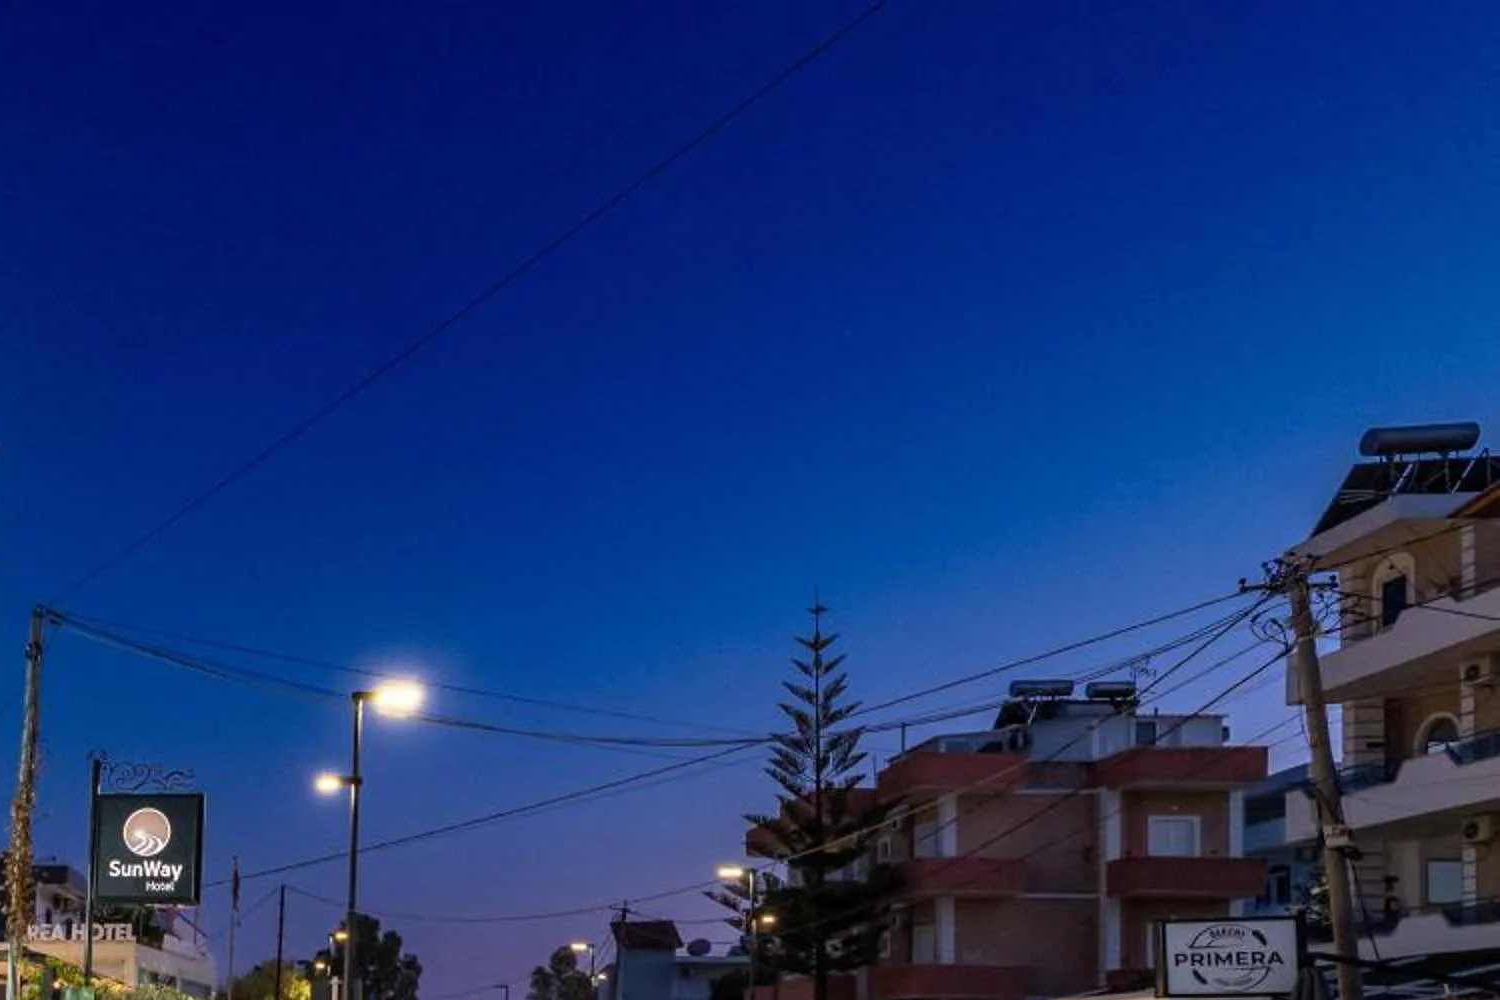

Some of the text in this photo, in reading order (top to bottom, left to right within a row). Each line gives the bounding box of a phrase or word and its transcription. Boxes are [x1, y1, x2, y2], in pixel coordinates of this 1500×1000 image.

[109, 859, 183, 882] SunWay
[145, 881, 174, 891] Hotel
[71, 923, 136, 941] HOTEL
[1174, 952, 1284, 967] PRIMERA
